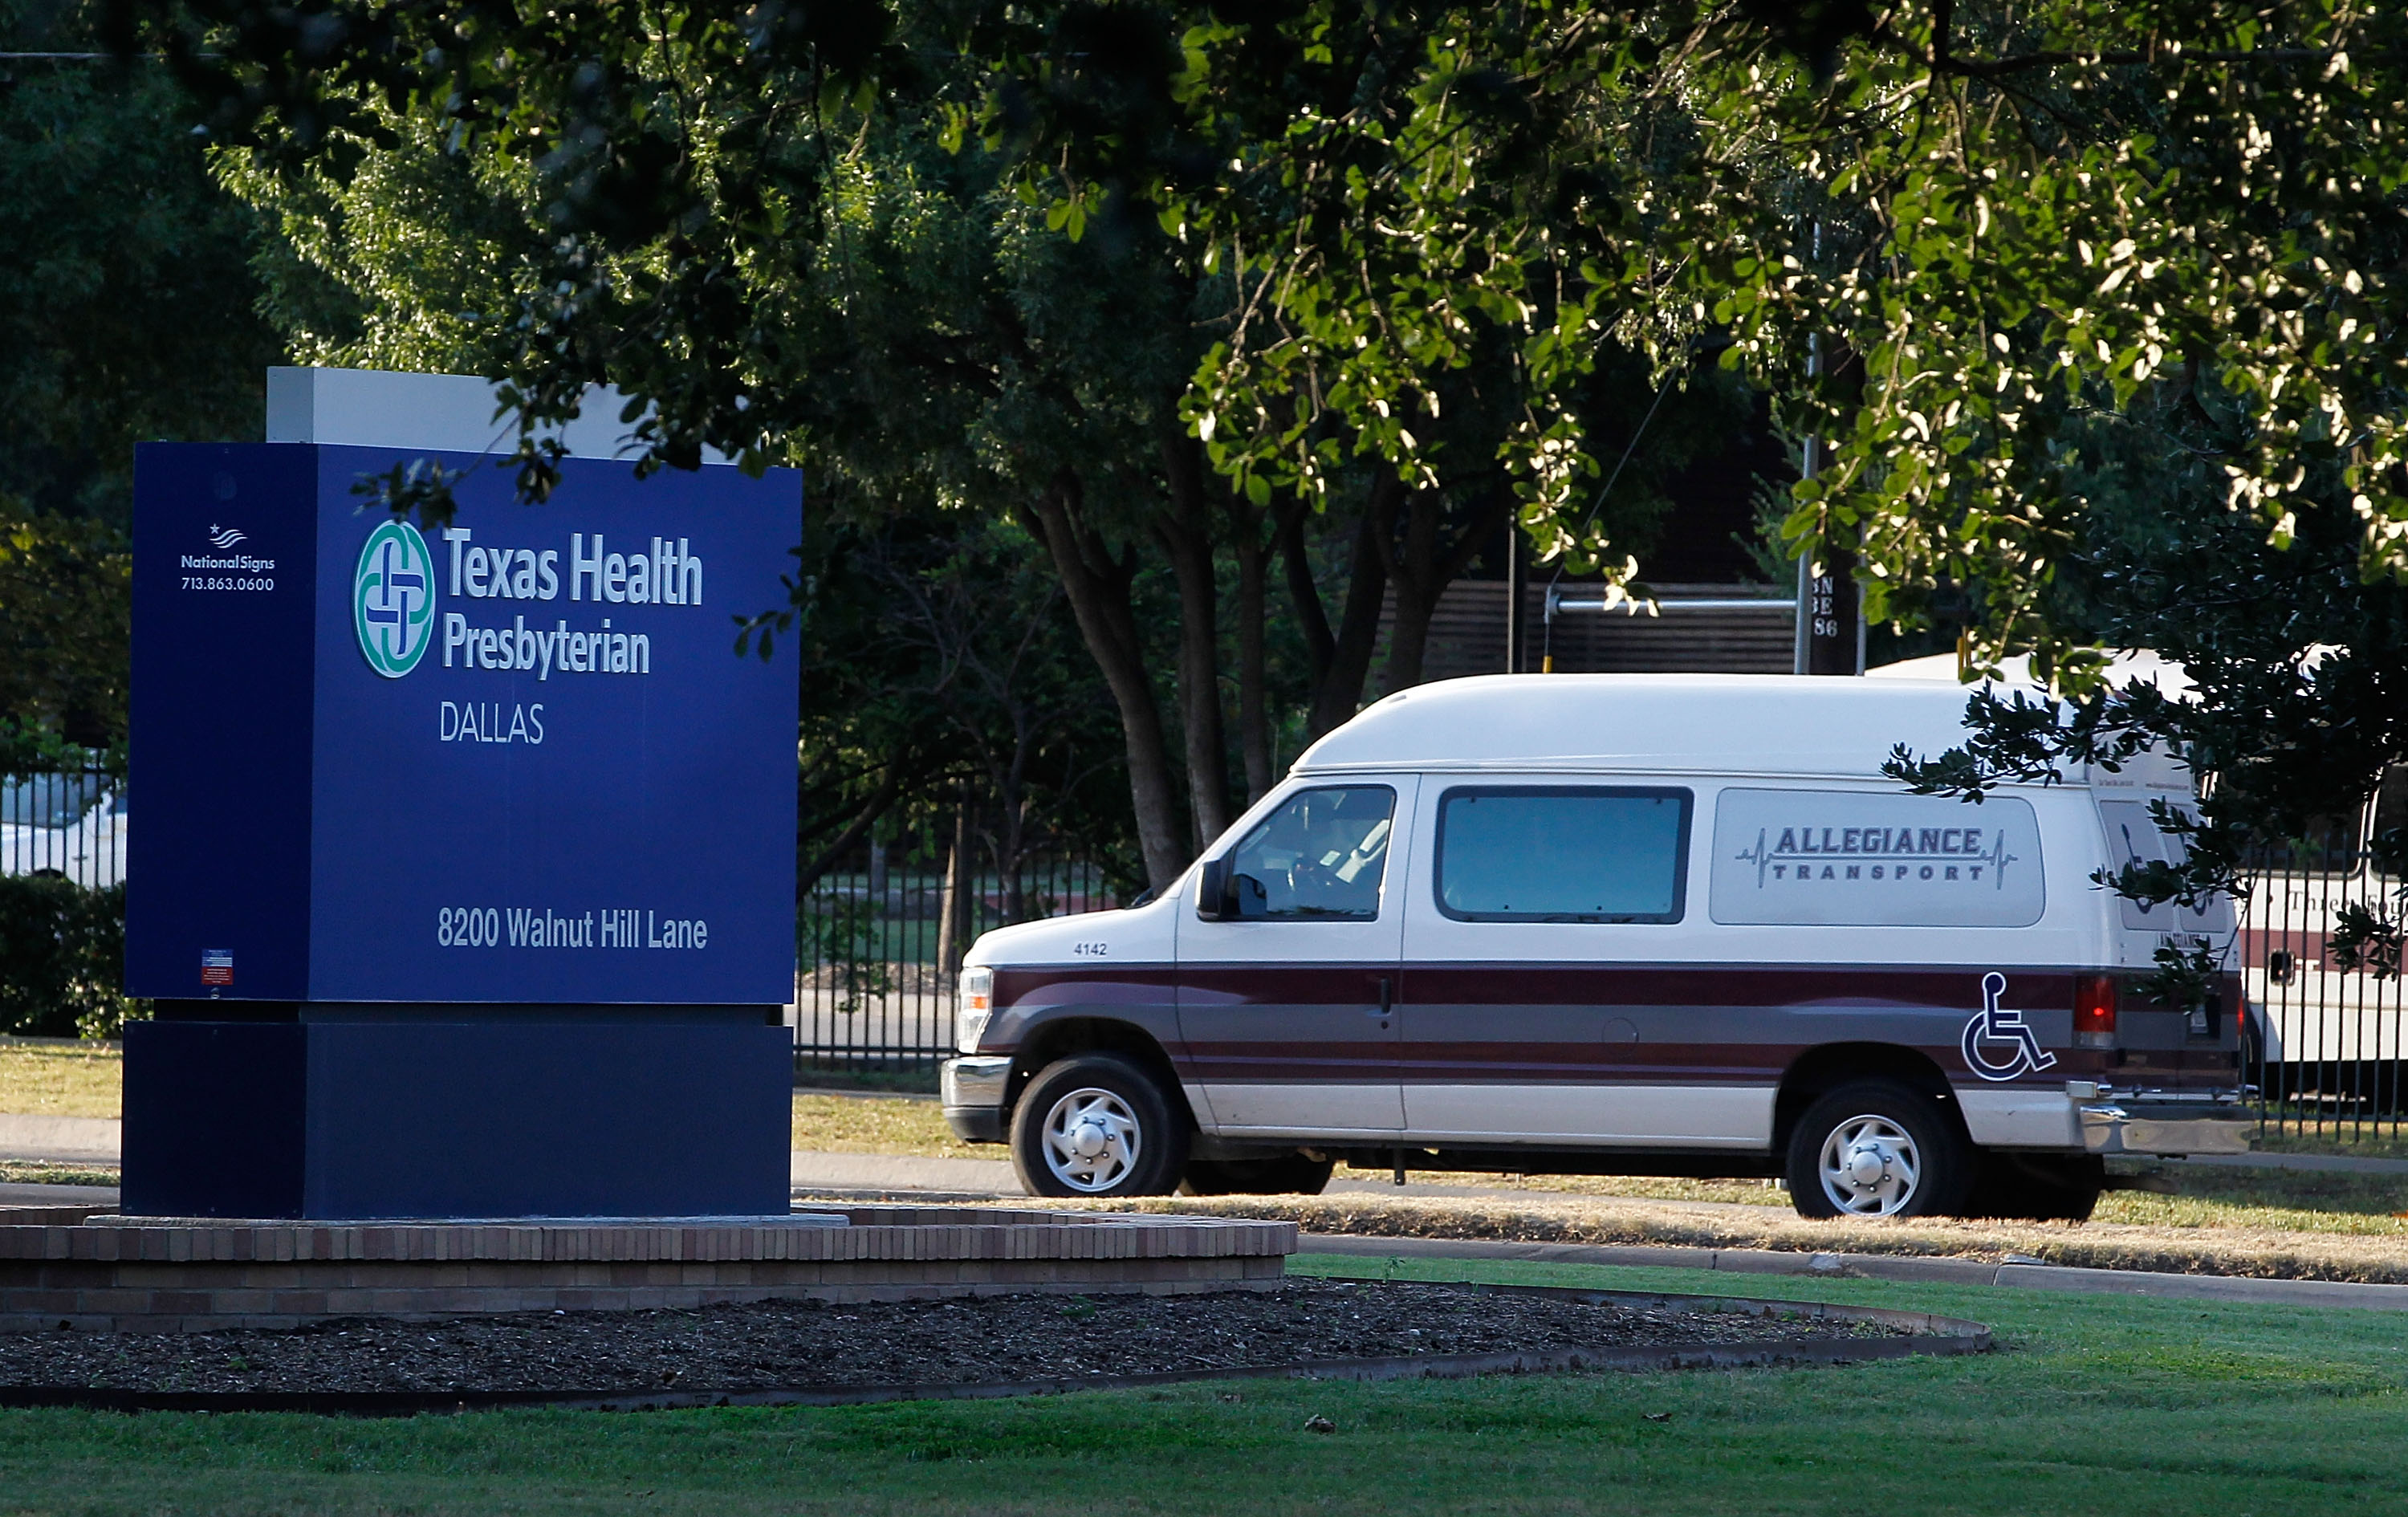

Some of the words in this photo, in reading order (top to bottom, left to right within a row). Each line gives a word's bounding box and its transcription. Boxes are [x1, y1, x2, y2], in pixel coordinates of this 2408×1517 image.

[442, 527, 559, 600] Texas
[570, 533, 702, 605] Health
[181, 577, 275, 591] 713.863.0600
[1814, 617, 1838, 637] 86
[442, 612, 650, 680] Presbyterian
[441, 701, 544, 745] DALLAS
[1775, 827, 1983, 854] ALLEGIANCE
[1772, 864, 1983, 881] TRANSPORT
[437, 907, 499, 947] 8200
[506, 908, 593, 947] Walnut
[601, 909, 640, 948] Hill
[648, 909, 708, 949] Lane
[1074, 943, 1108, 956] 4142
